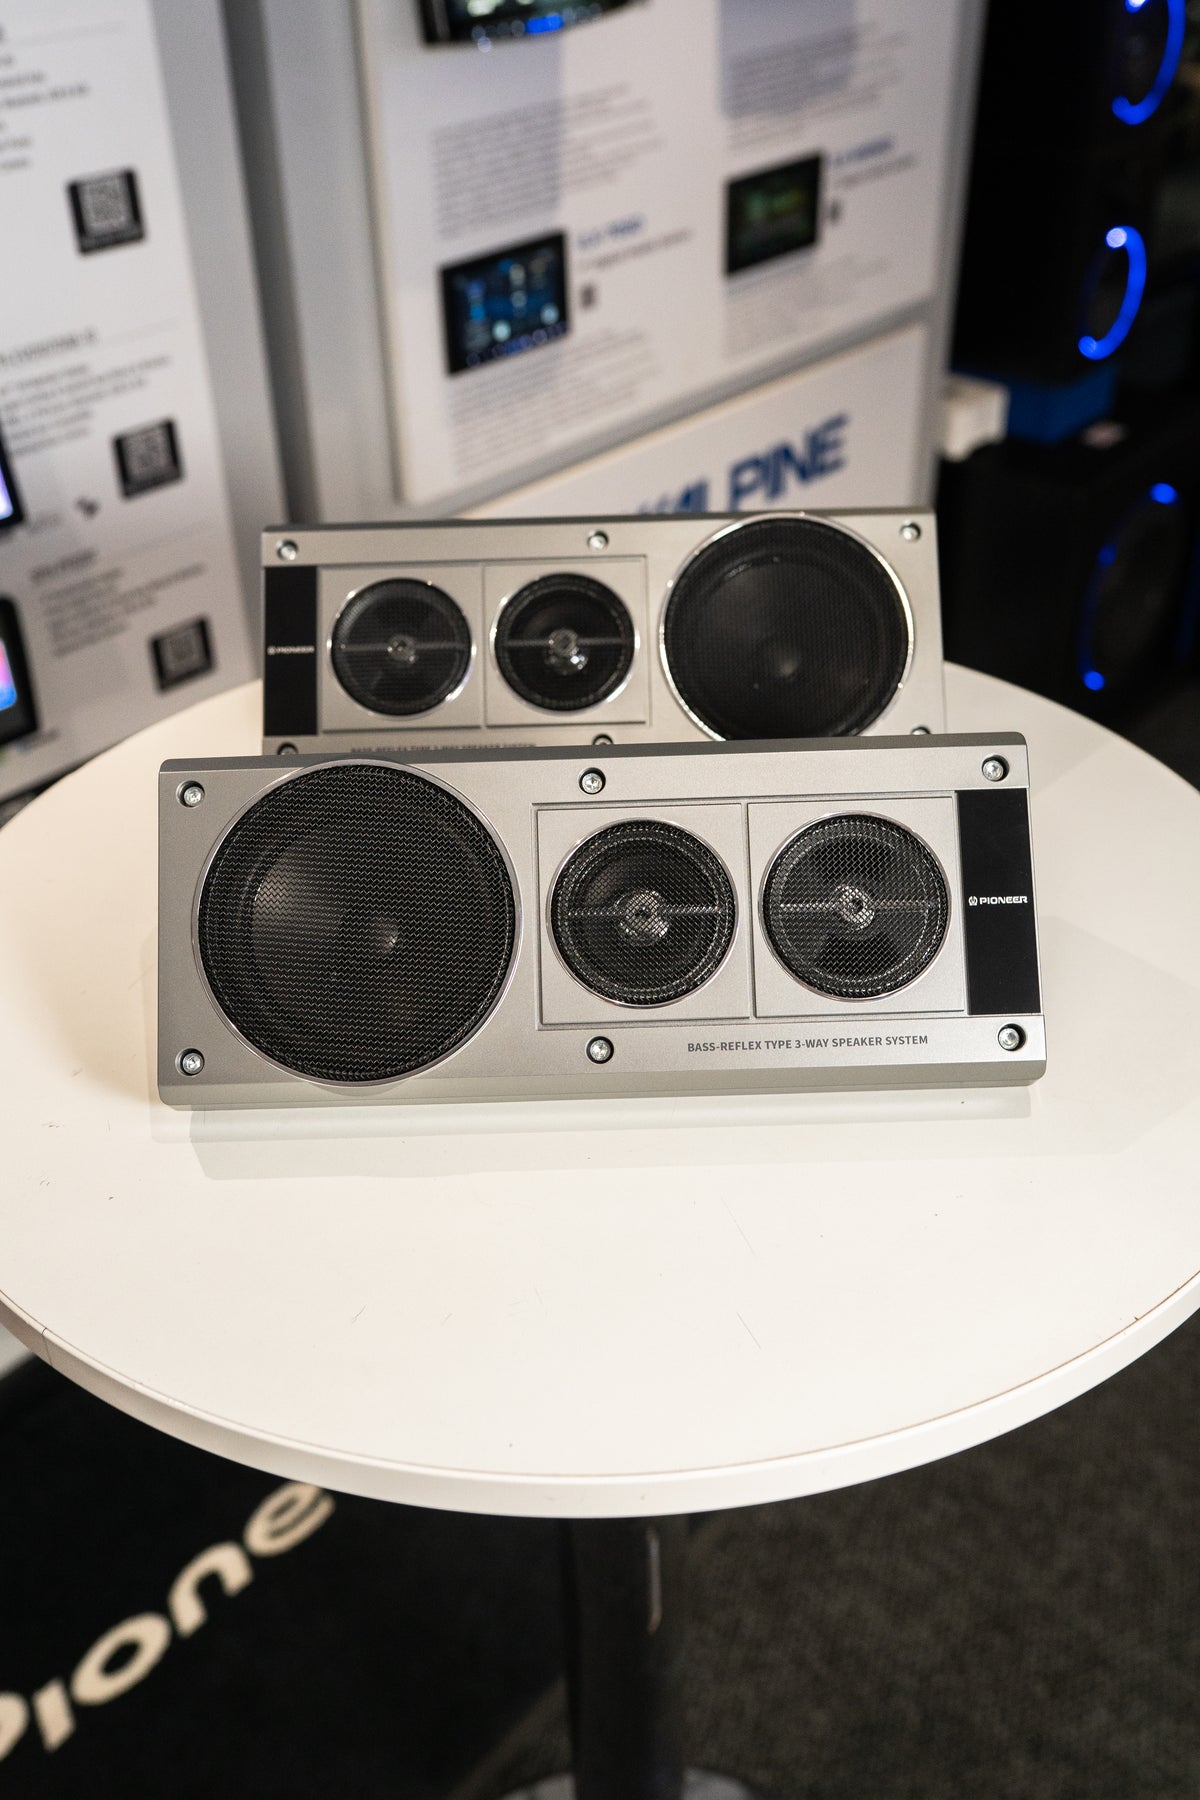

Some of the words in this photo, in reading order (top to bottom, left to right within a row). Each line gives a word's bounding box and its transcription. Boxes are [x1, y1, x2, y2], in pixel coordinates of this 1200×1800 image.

[979, 895, 1028, 905] PIONEER
[687, 1040, 763, 1053] BASS-REFLEX
[764, 1039, 792, 1050] TYPE
[794, 1037, 830, 1049] 3-WAY
[831, 1036, 883, 1048] SPEAKER
[885, 1034, 929, 1046] SYSTEM
[0, 1480, 336, 1762] ione
